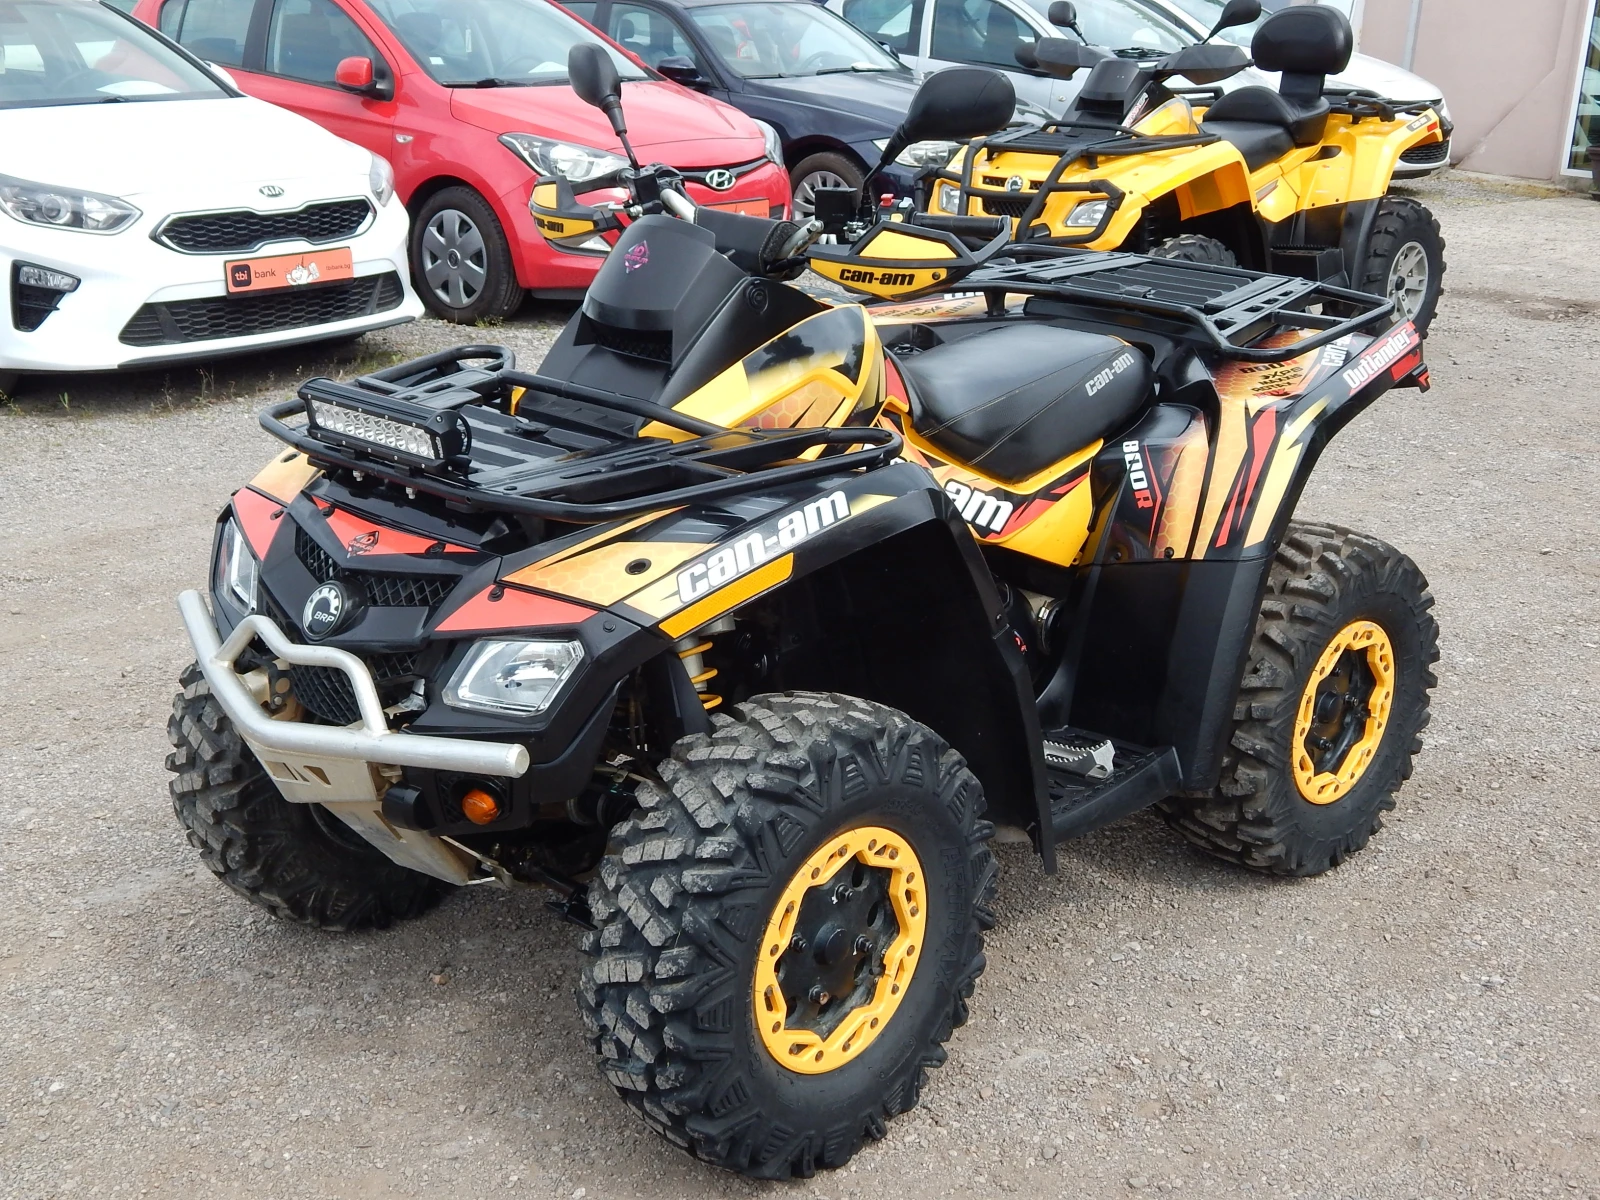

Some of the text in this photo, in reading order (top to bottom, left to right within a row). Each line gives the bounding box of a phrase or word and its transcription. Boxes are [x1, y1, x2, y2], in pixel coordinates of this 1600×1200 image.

[261, 186, 283, 196] KIA
[235, 269, 276, 280] tbi bank
[839, 268, 915, 285] can-am
[1342, 328, 1411, 389] Outlander
[1085, 353, 1135, 396] can-am
[1122, 440, 1153, 508] 800R
[677, 490, 851, 603] can-am
[313, 611, 335, 623] BRP
